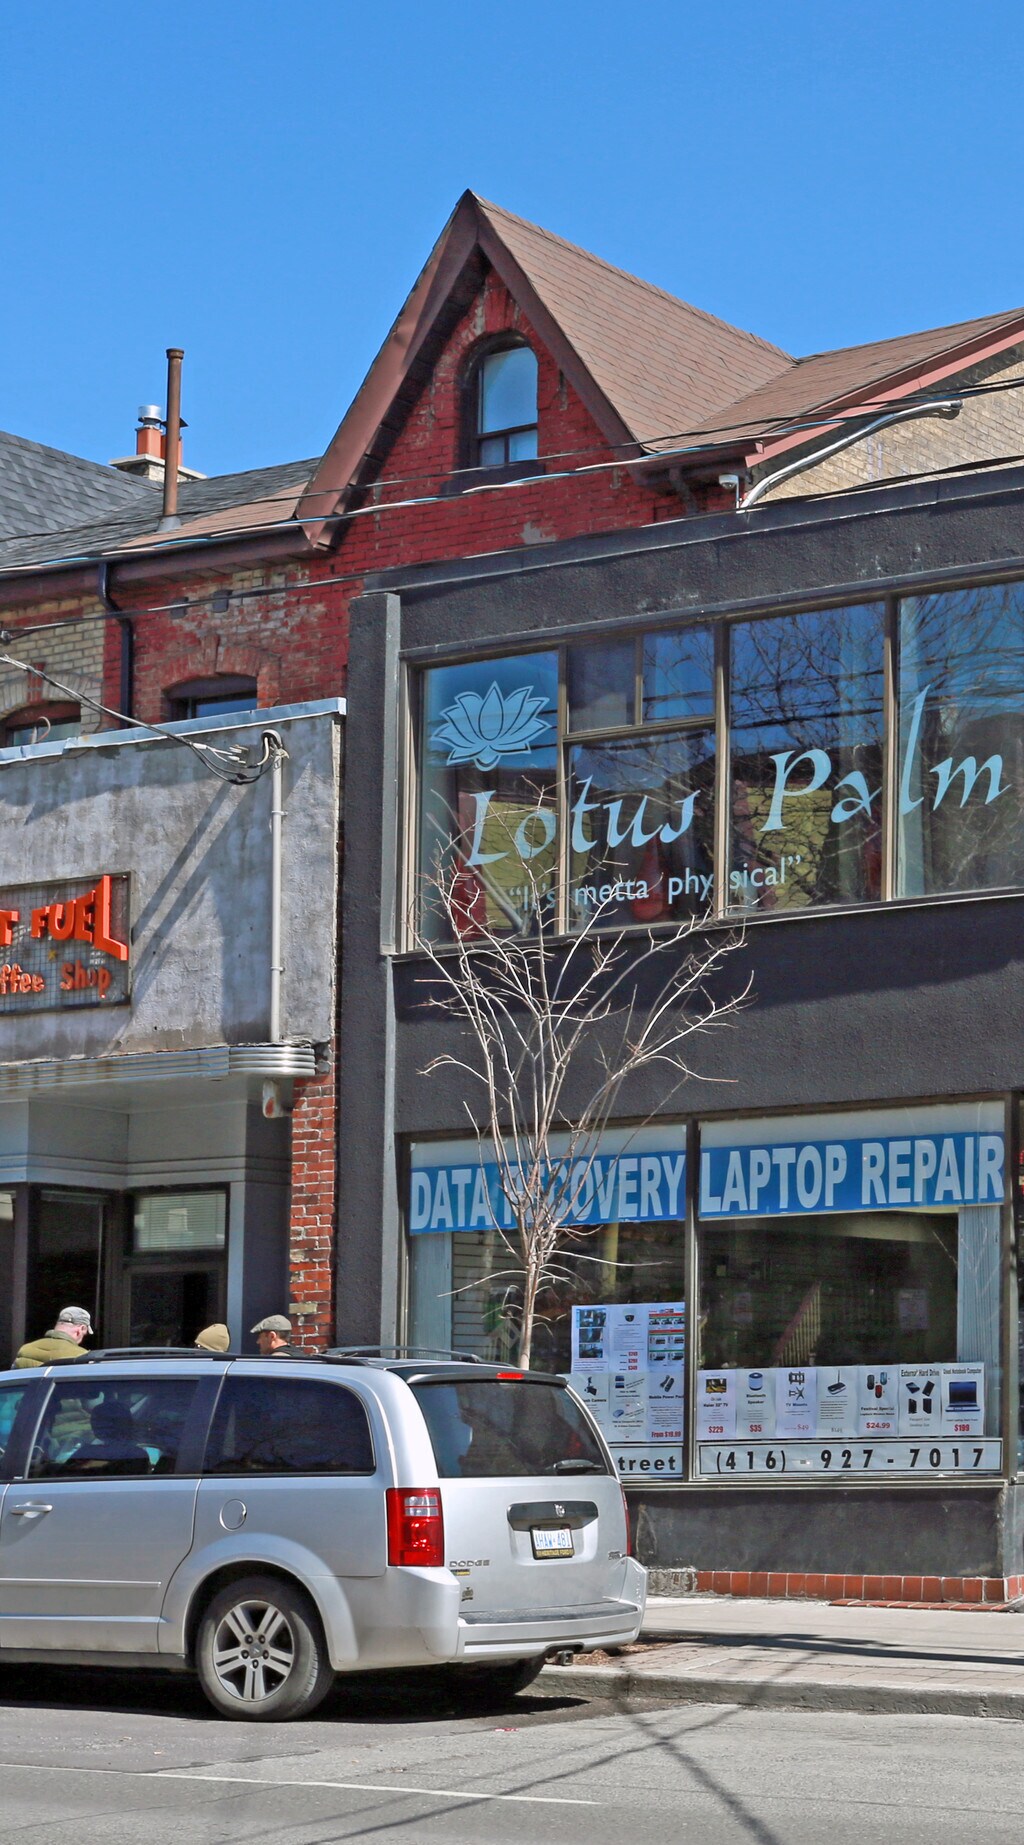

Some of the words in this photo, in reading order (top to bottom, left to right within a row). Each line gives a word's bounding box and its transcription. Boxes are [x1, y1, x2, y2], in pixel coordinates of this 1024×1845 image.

[464, 775, 701, 867] Lotus
[758, 684, 1012, 832] Palm
[575, 878, 650, 905] metta
[668, 867, 714, 904] phy
[31, 875, 129, 961] FUEL
[60, 959, 111, 999] Shop
[411, 1167, 494, 1231] DATA
[701, 1144, 848, 1213] LAPTOP
[861, 1135, 1005, 1205] REPAIR
[618, 1455, 676, 1471] treet
[450, 1559, 490, 1568] DODGE
